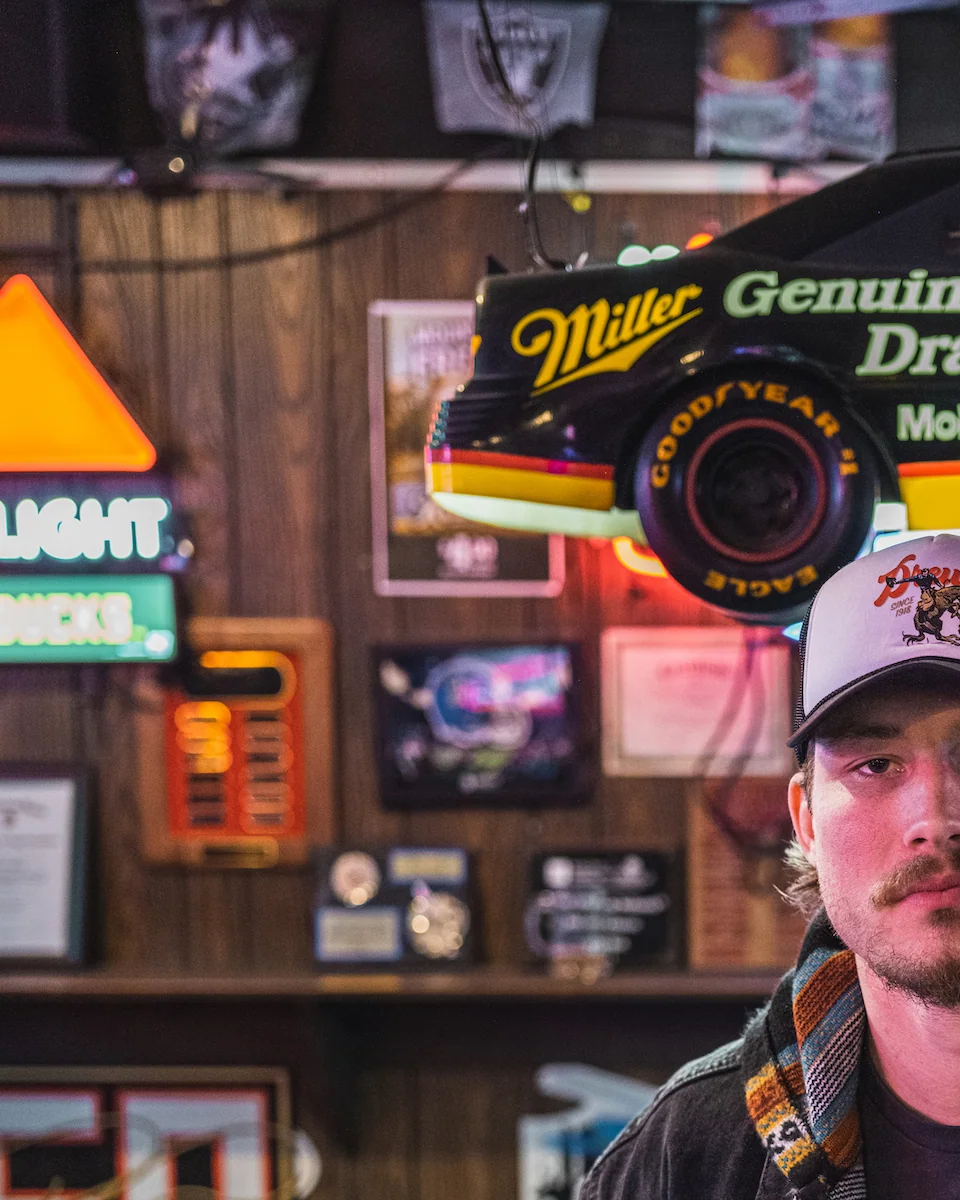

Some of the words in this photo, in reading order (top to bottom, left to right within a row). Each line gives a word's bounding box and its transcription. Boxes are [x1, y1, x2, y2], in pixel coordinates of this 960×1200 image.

[511, 284, 702, 397] Miller
[651, 380, 840, 489] GOODYEAR
[704, 565, 819, 598] EAGLE
[890, 596, 915, 611] SINCE
